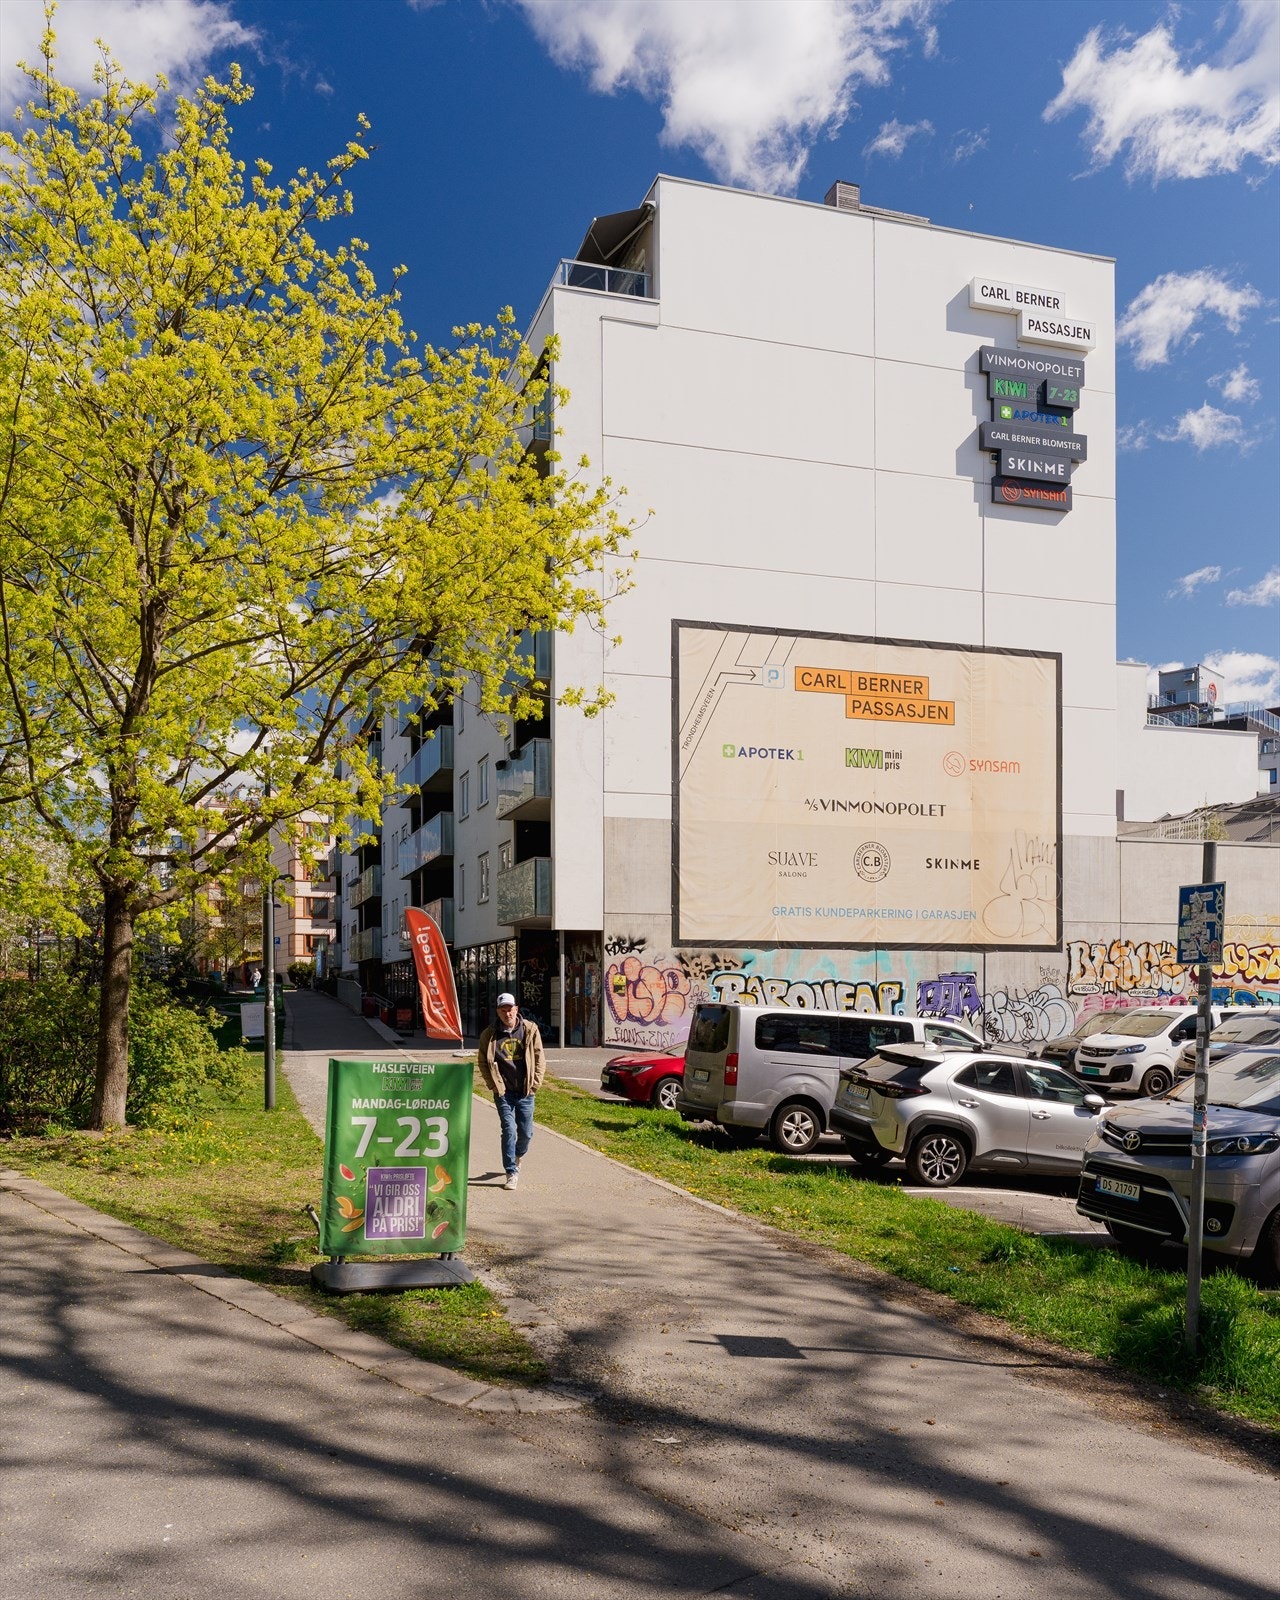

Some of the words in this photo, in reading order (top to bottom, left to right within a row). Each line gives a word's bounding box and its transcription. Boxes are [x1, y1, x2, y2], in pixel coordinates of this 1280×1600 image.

[980, 285, 1011, 301] CARL
[1016, 291, 1060, 309] BERNER
[1028, 319, 1091, 340] PASSASJEN
[986, 354, 1082, 378] VINMONOPOLET
[994, 378, 1028, 399] KIWI
[1013, 409, 1060, 425] APOTEK
[1061, 416, 1068, 427] 1
[990, 431, 1010, 441] CARL
[1011, 434, 1041, 446] BERNER
[1042, 439, 1081, 451] BLOMSTER
[1008, 457, 1065, 476] SKINME
[1023, 487, 1067, 503] SYNSAM
[800, 672, 847, 690] CARL
[857, 676, 924, 696] BERNER
[681, 687, 716, 751] TRONDHEIMSVEIEN
[851, 700, 949, 721] PASSASJEN
[737, 746, 795, 761] APOTEK
[797, 750, 805, 761] 1
[845, 747, 884, 770] KIWI
[884, 749, 903, 760] mini
[884, 760, 901, 772] pris
[968, 758, 1021, 775] SYNSAM
[819, 799, 947, 818] VINMONOPOLET
[768, 851, 819, 868] SUAVE
[862, 856, 881, 867] C.B
[925, 858, 981, 871] SKINME
[778, 871, 808, 879] SALONG
[771, 906, 813, 918] GRATIS
[814, 907, 913, 920] KUNDEPARKERING
[921, 910, 978, 921] GARASJEN
[372, 1063, 435, 1075] HASLEVEIEN
[381, 1076, 411, 1092] KIWI
[352, 1098, 450, 1110] MANDAG-LØRDAG
[351, 1116, 449, 1158] 7-23
[385, 1184, 401, 1196] GIR
[402, 1183, 421, 1196] OSS
[1102, 1179, 1112, 1191] DS
[1114, 1182, 1138, 1197] 21797
[373, 1196, 420, 1217] ALDRI
